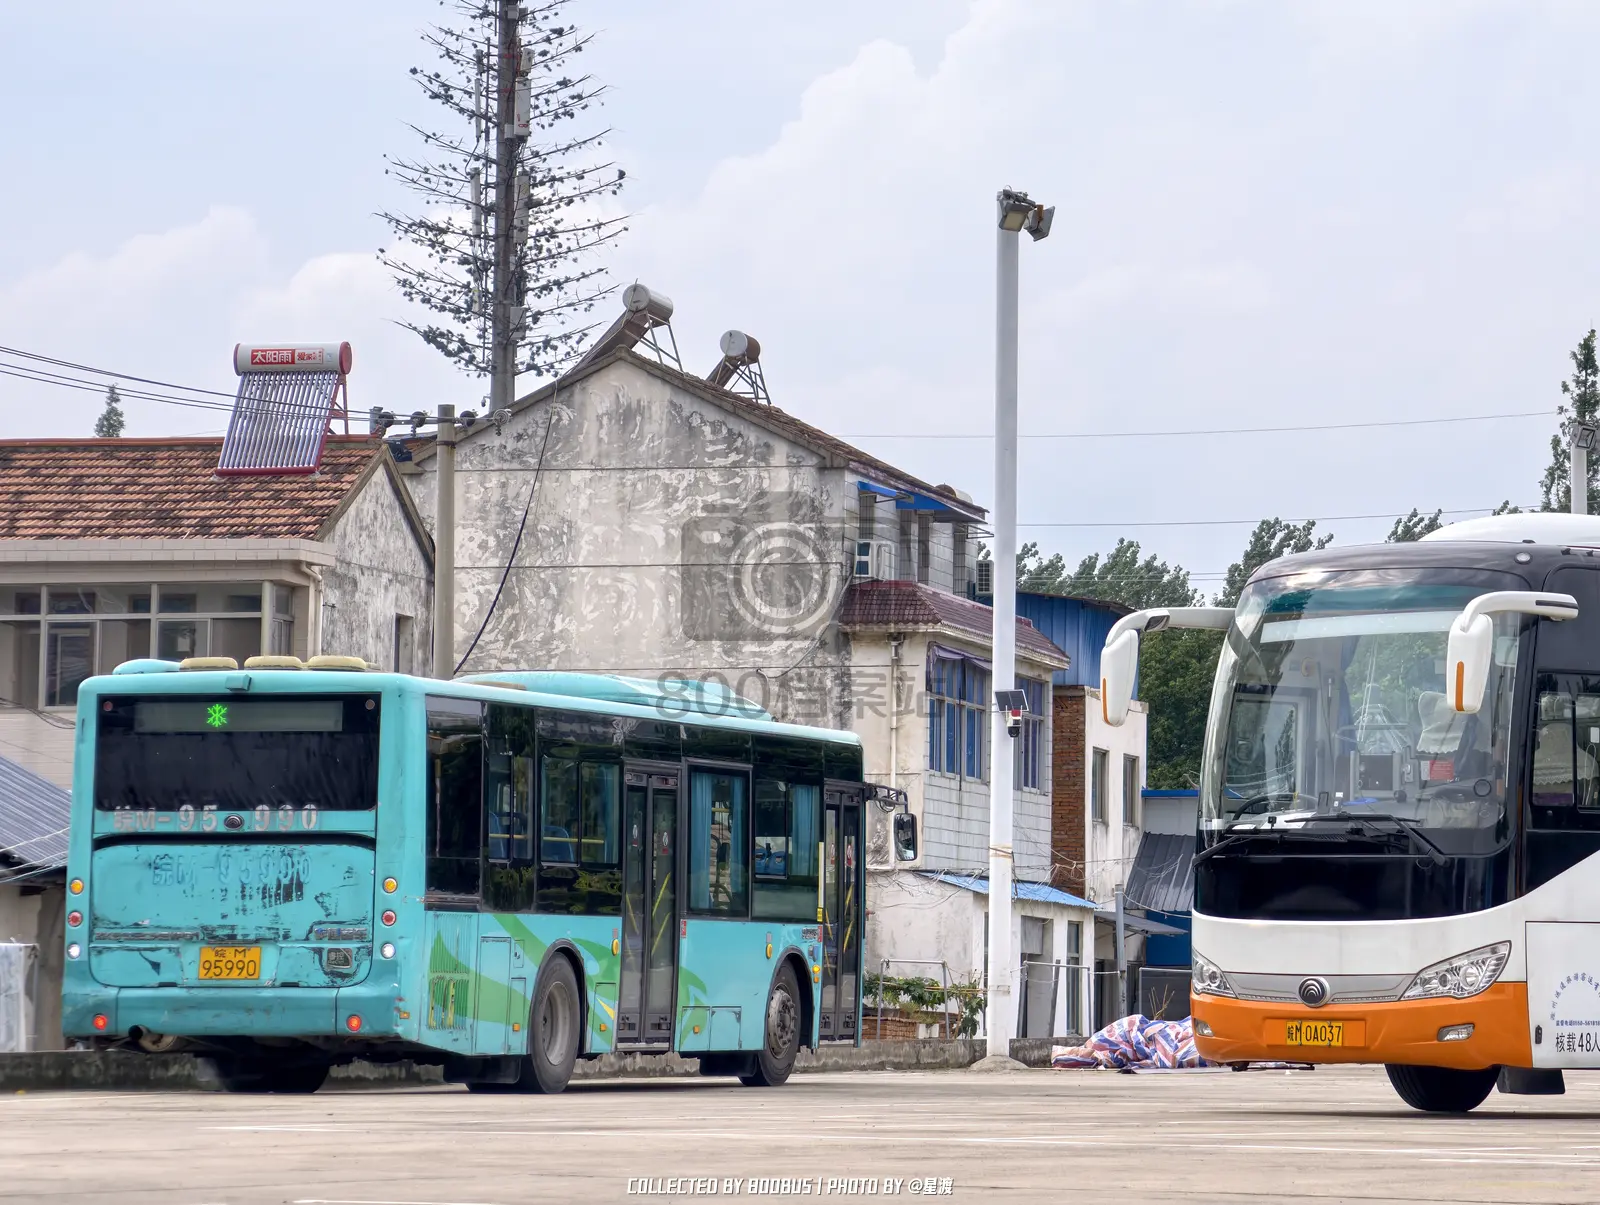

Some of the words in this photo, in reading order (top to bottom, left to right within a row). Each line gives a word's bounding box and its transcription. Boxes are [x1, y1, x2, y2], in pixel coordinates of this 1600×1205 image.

[252, 350, 292, 363] 太阳雨
[202, 959, 257, 977] 95990
